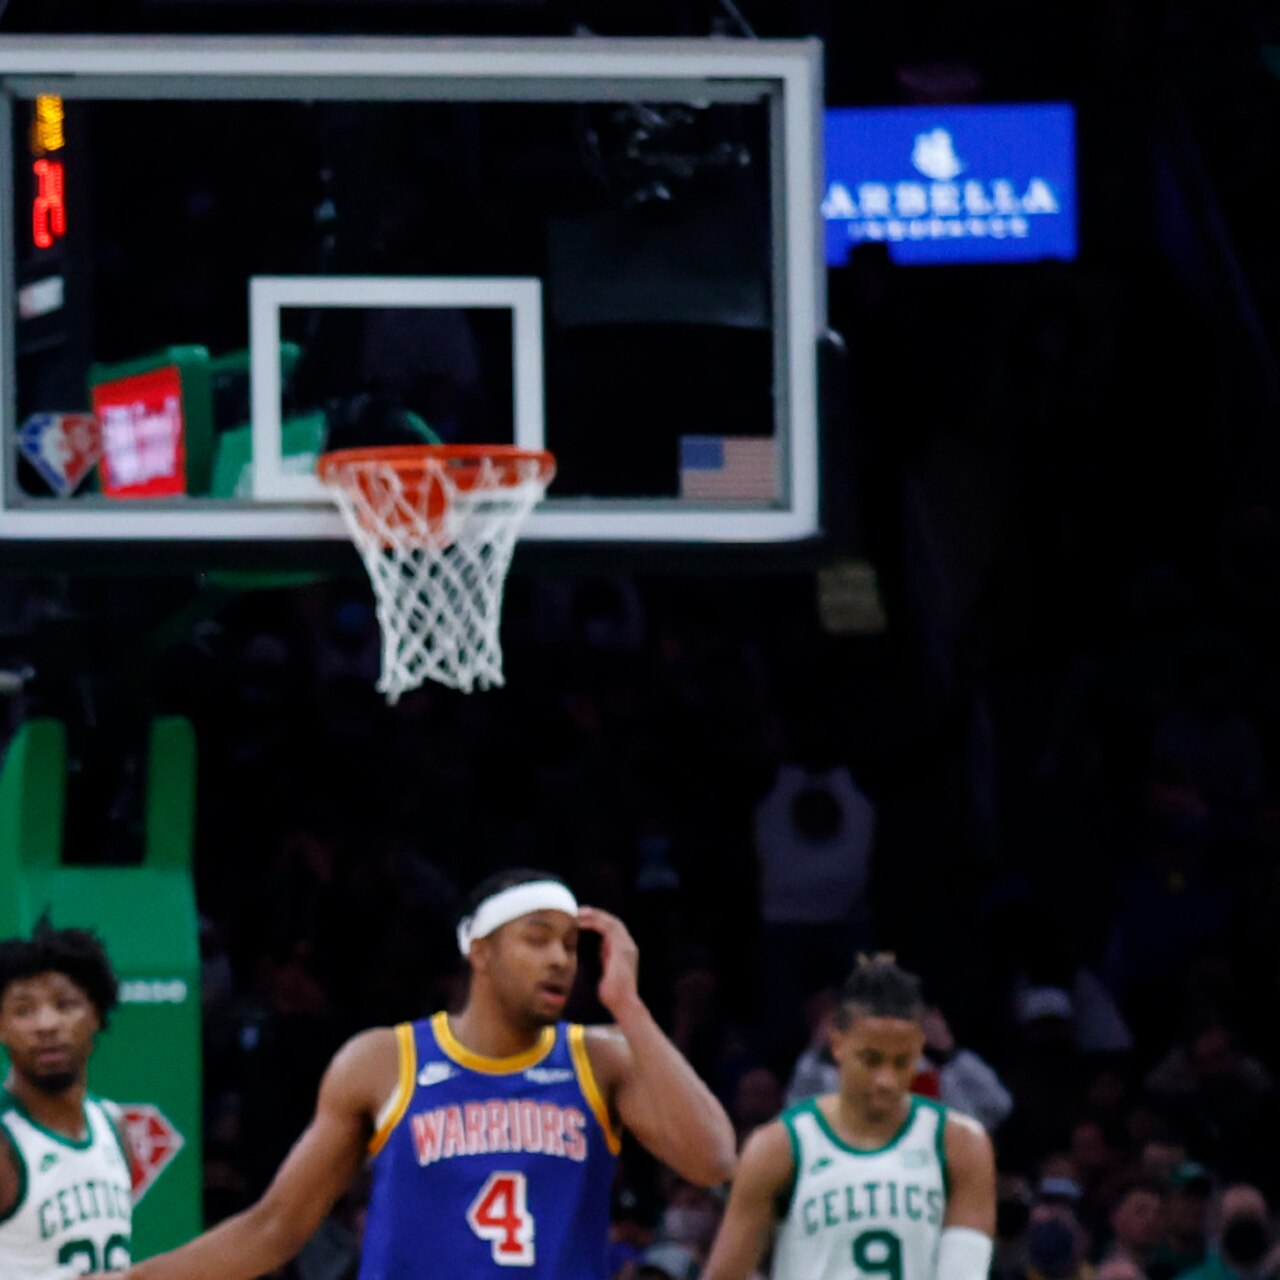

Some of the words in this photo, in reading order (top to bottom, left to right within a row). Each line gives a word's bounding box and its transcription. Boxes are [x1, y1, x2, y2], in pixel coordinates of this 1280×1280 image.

[412, 1098, 588, 1167] WARRIORS
[39, 1180, 132, 1241] CELTIC
[466, 1170, 536, 1267] 4
[803, 1181, 945, 1236] CELTICS
